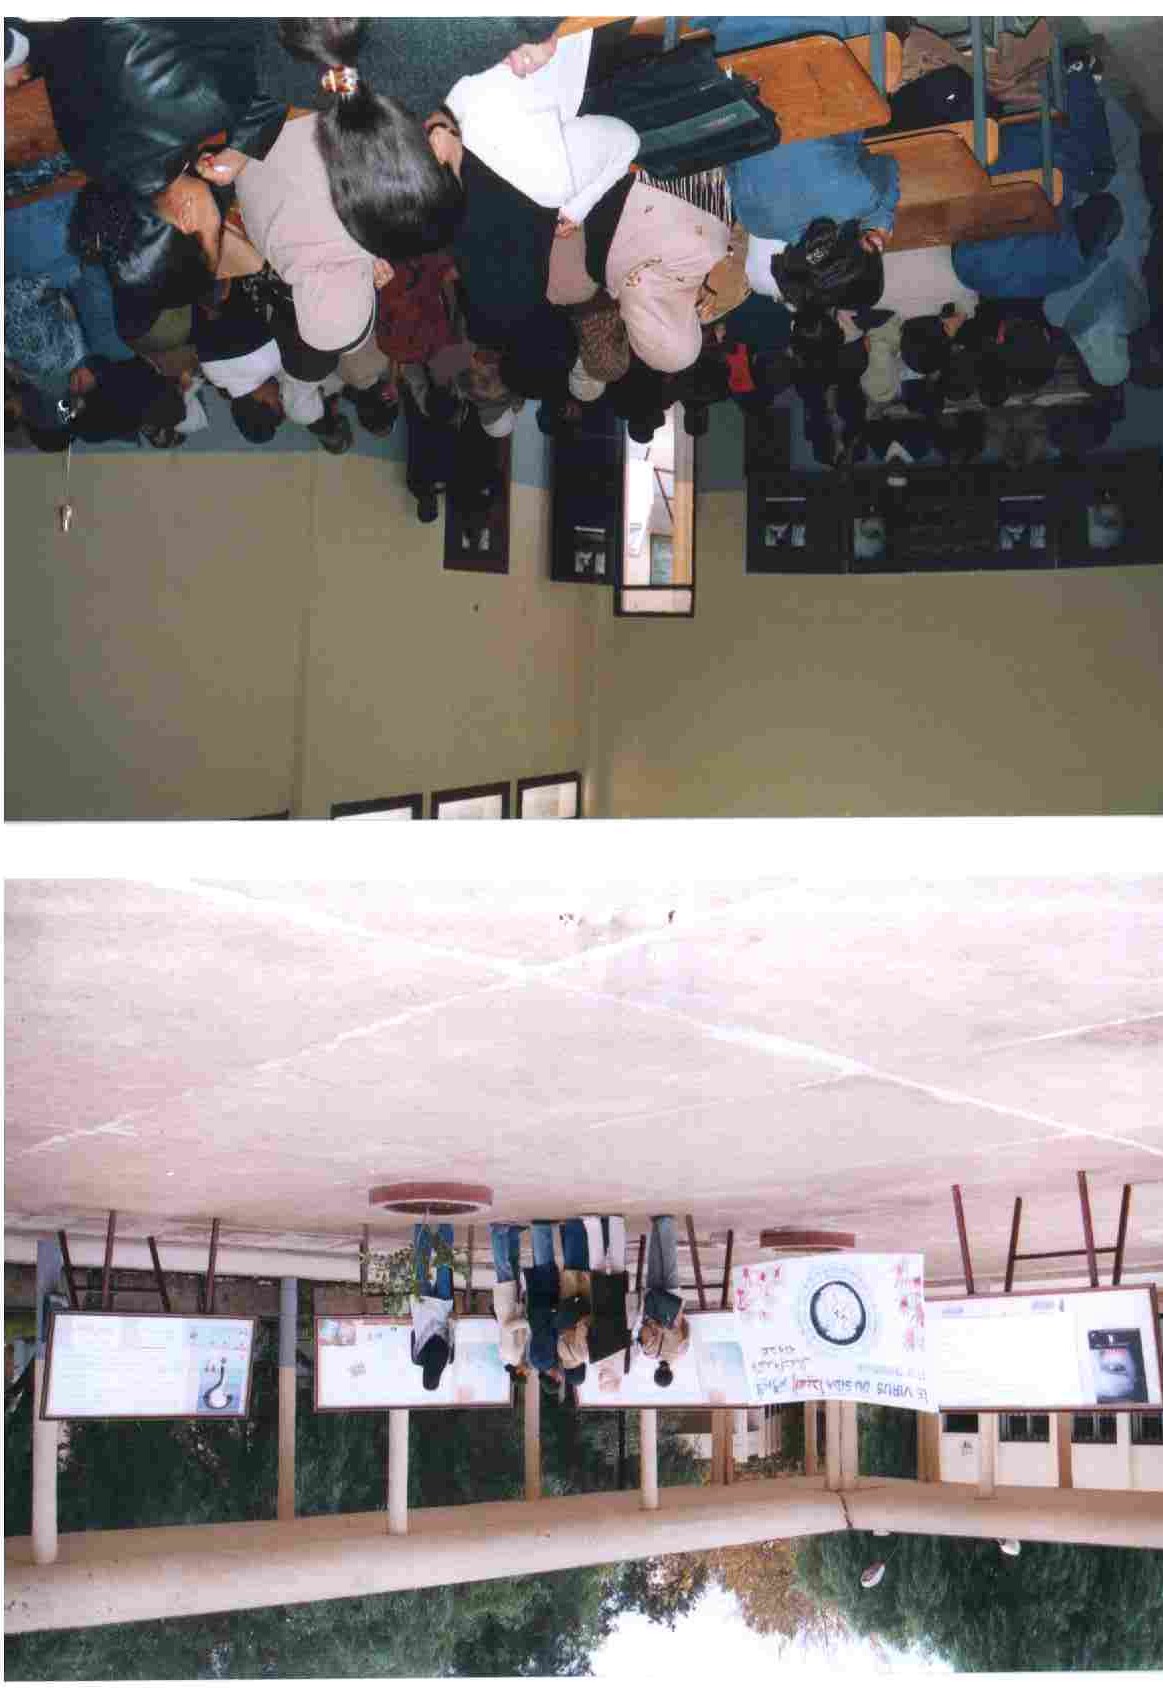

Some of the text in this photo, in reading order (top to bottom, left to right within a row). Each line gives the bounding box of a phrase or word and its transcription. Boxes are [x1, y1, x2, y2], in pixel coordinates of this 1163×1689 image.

[826, 1377, 853, 1392] SIDA
[854, 1380, 871, 1393] DU
[877, 1382, 914, 1399] VIRUS
